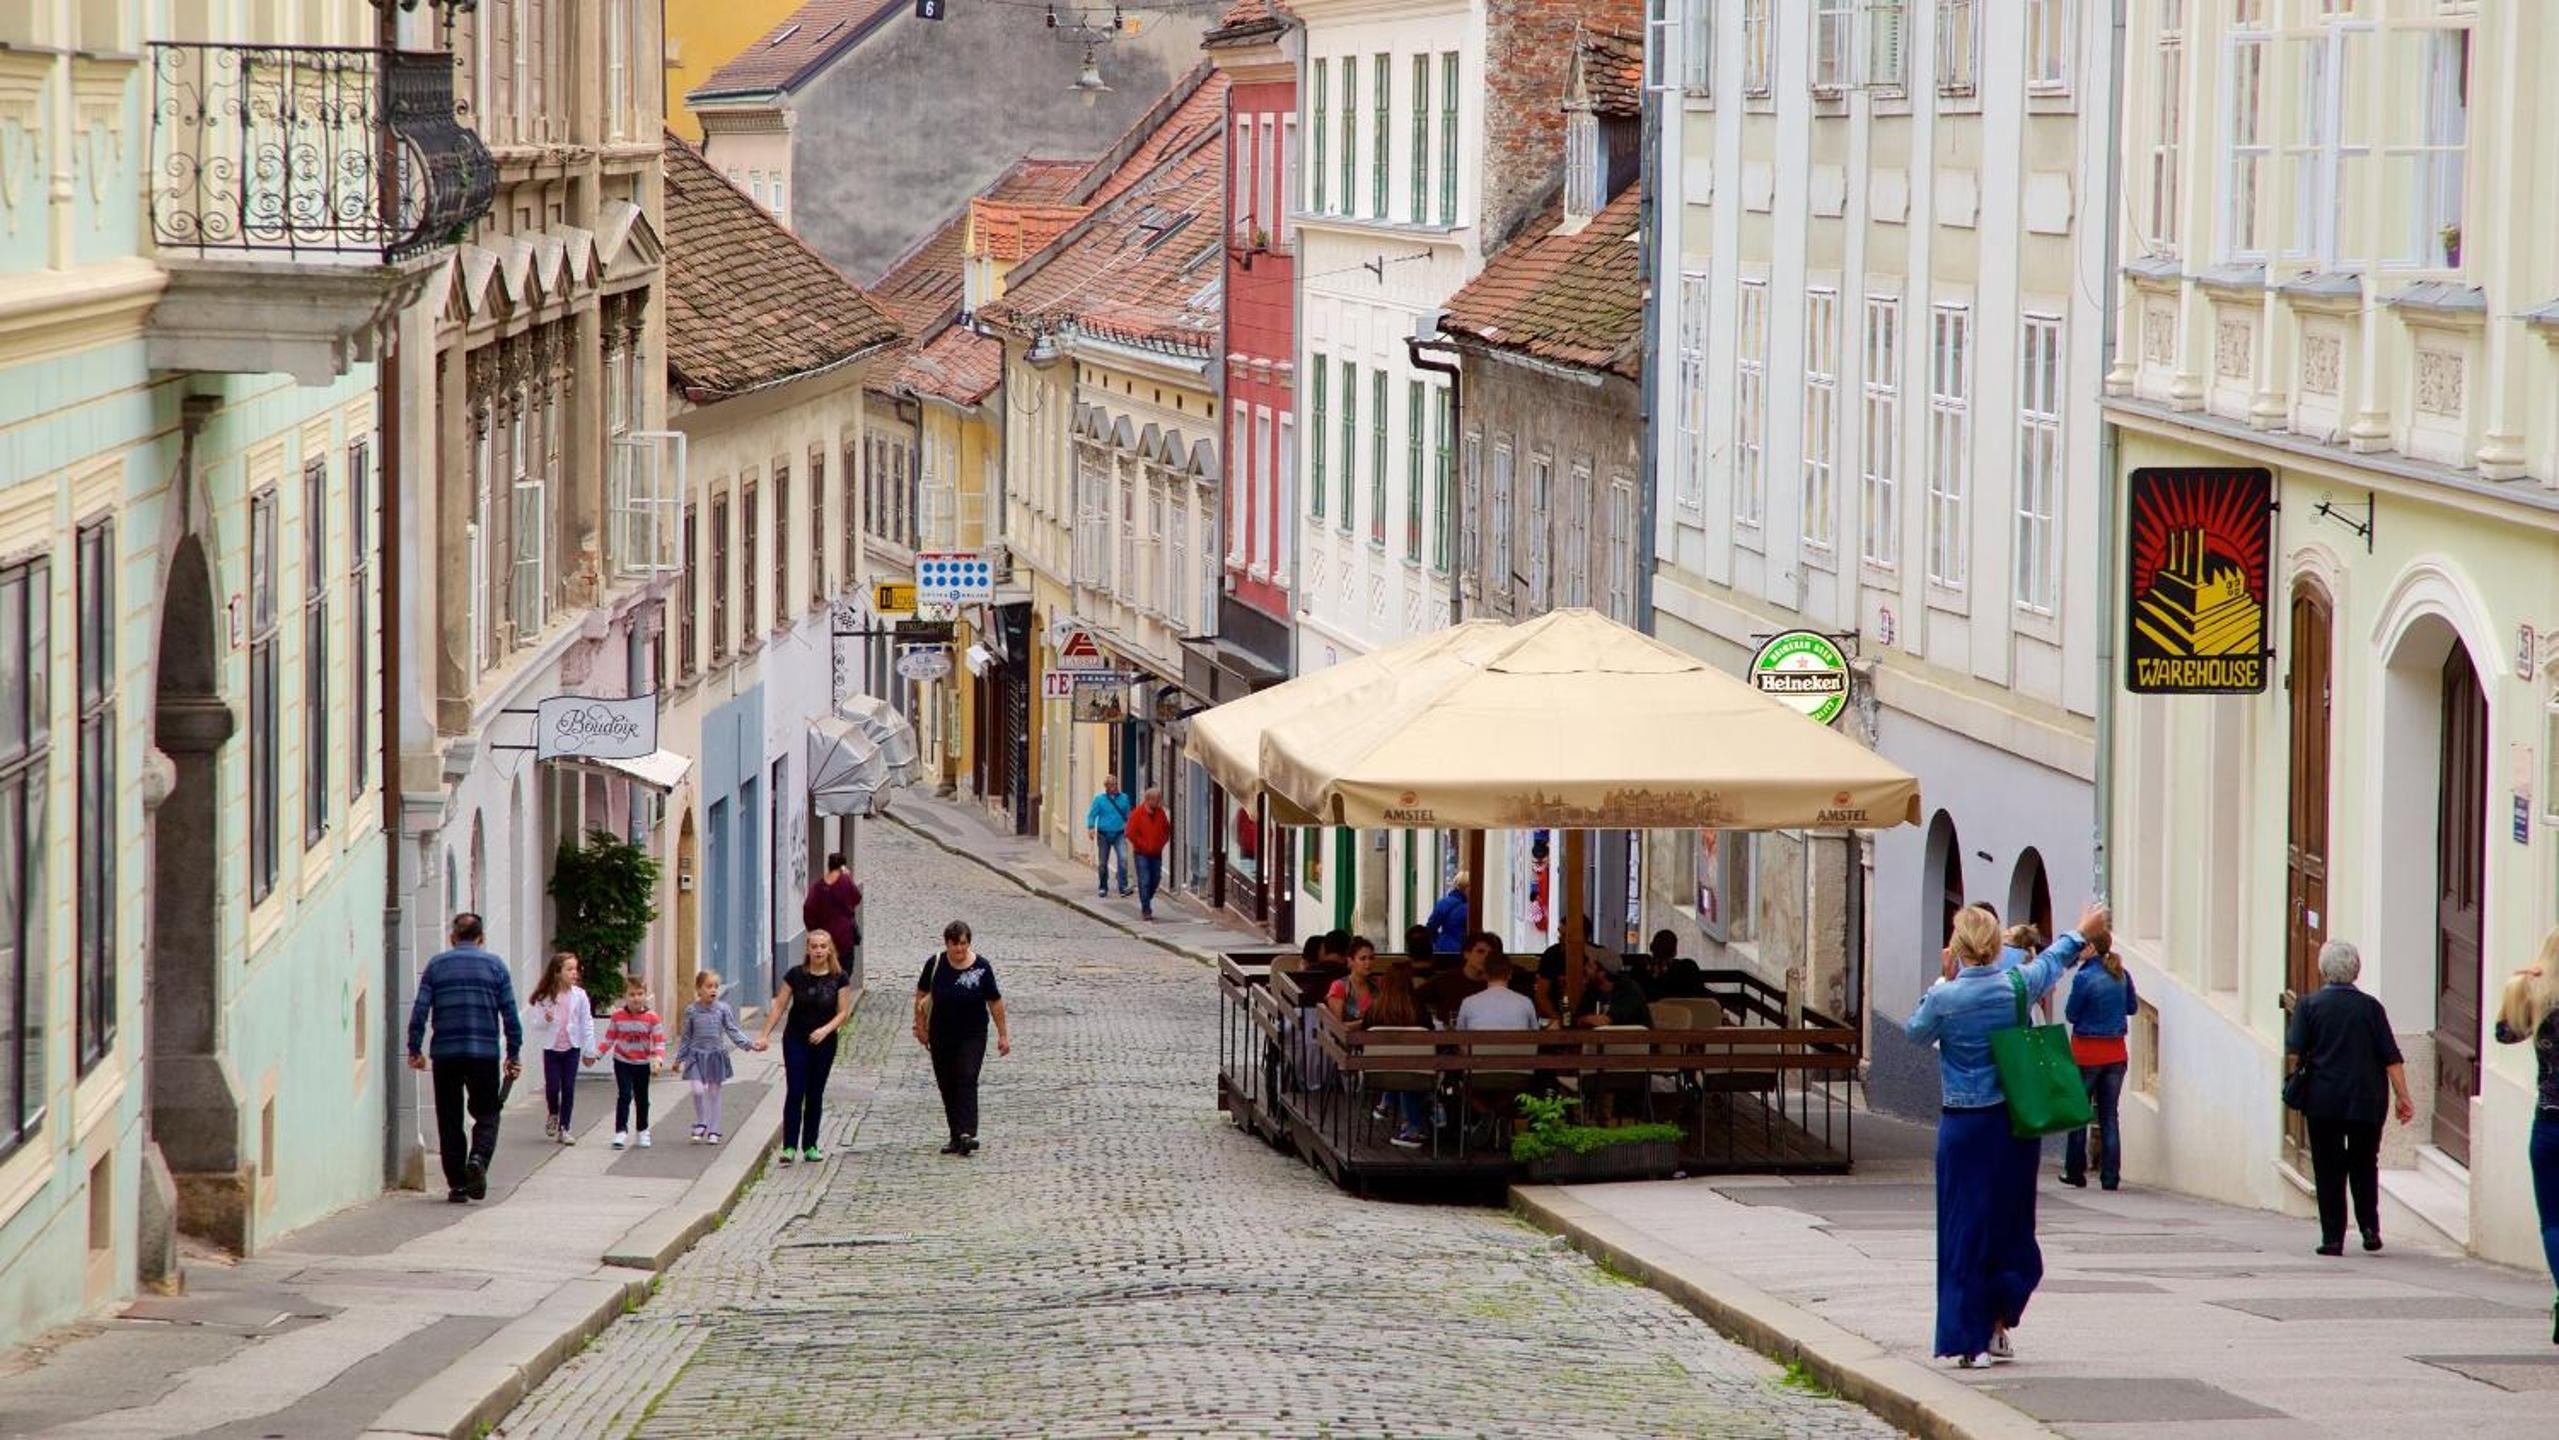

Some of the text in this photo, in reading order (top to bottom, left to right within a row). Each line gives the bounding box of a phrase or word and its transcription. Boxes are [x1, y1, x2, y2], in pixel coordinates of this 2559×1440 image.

[926, 1, 935, 17] 6
[2137, 658, 2259, 687] WAREHOUSE
[1761, 675, 1841, 691] Heineken
[555, 703, 640, 745] Boudoir
[1383, 809, 1436, 821] AMSTEL
[1816, 809, 1868, 821] AMSTEL
